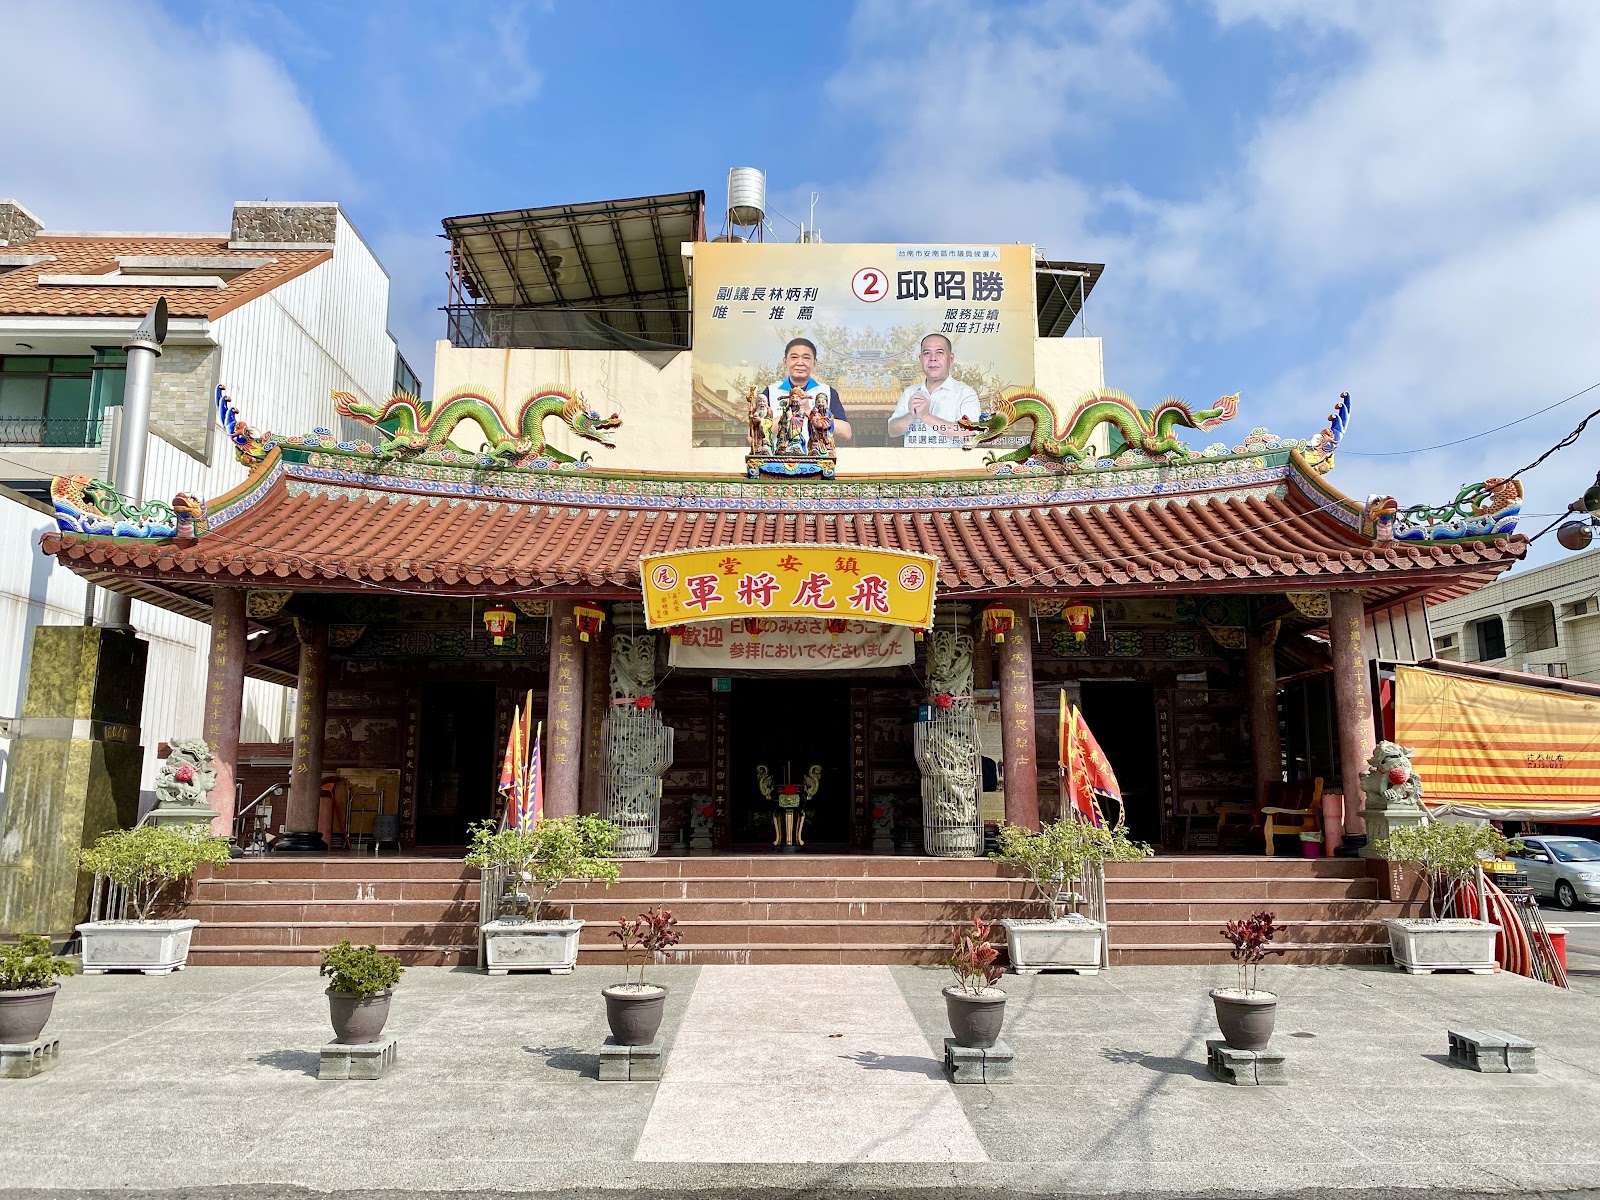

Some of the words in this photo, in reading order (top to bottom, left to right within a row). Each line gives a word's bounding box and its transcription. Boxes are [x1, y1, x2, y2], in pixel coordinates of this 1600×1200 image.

[898, 249, 998, 258] 台南市安南區市議員候選人
[715, 286, 819, 303] 副議長林炳利
[864, 273, 879, 295] 2
[896, 270, 1004, 302] 邱昭勝
[711, 305, 816, 321] 唯一推薦
[944, 308, 1000, 321] 服務延續
[718, 554, 860, 576] 鎮安堂
[657, 568, 674, 584] 尾
[903, 569, 921, 586] 海
[684, 572, 890, 613] 飛虎將軍
[681, 626, 723, 648] 歓迎
[729, 640, 902, 660] 参拝においでくださいました
